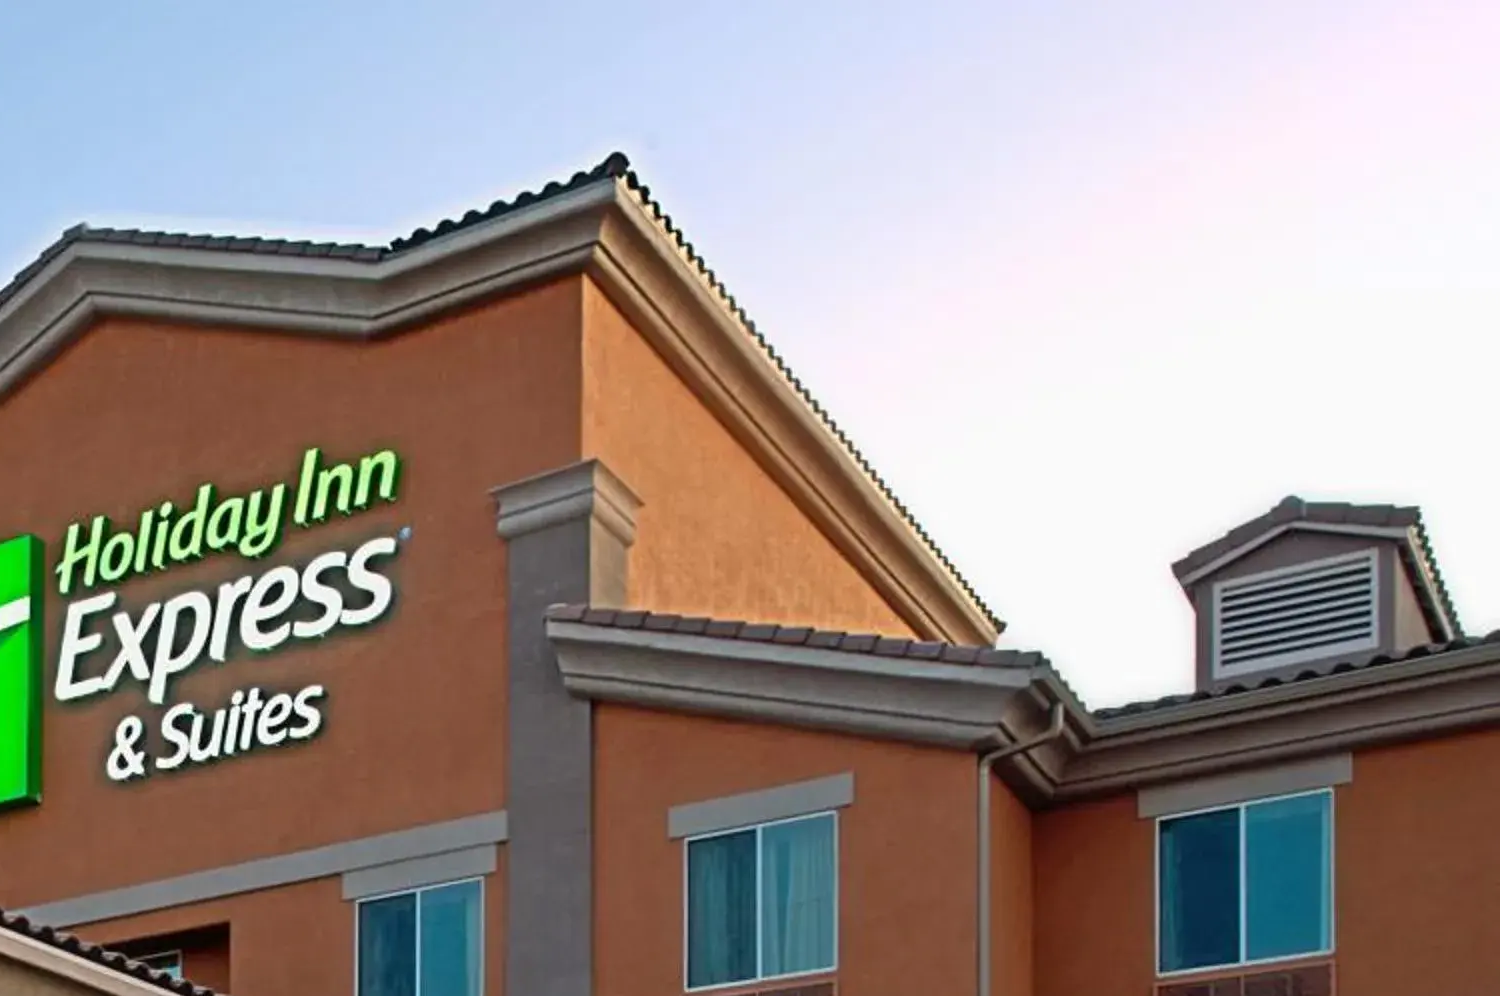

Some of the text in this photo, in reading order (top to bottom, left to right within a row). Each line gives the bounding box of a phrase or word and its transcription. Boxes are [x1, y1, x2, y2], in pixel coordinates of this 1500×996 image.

[56, 447, 397, 594] Holiday Inn
[55, 537, 396, 704] Express
[106, 685, 324, 780] & Suites
